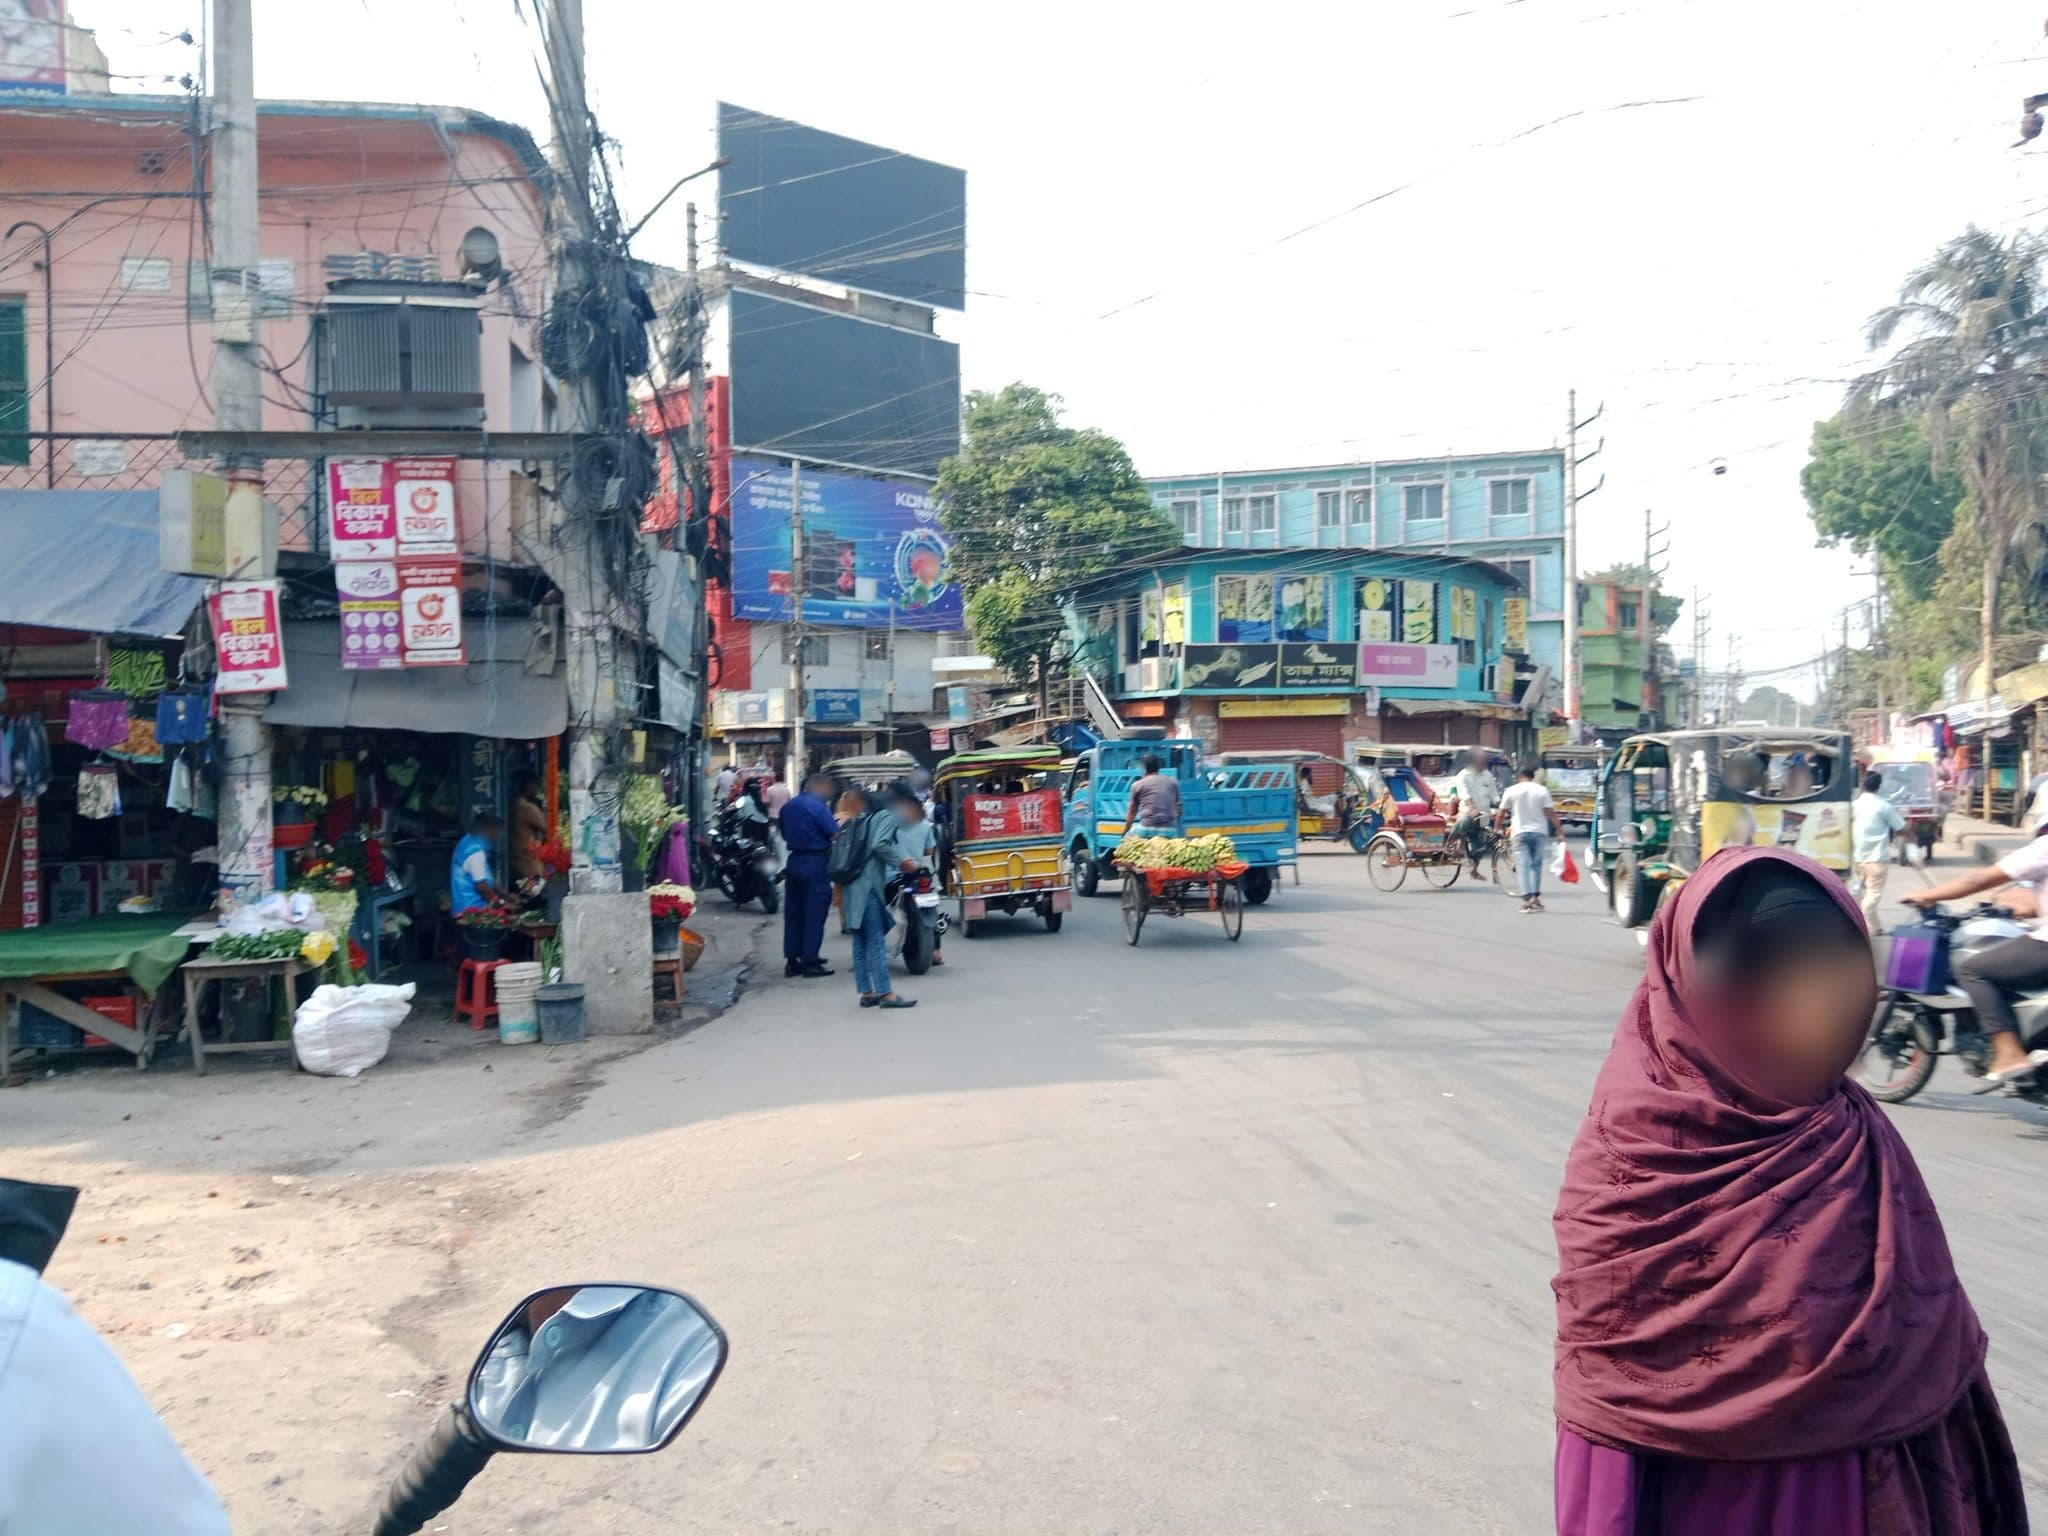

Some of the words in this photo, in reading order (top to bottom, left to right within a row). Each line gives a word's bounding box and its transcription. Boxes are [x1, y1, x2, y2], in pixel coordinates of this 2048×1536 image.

[336, 500, 391, 521] বিকাশ
[343, 520, 385, 535] করুন
[219, 631, 276, 652] বিকাশ
